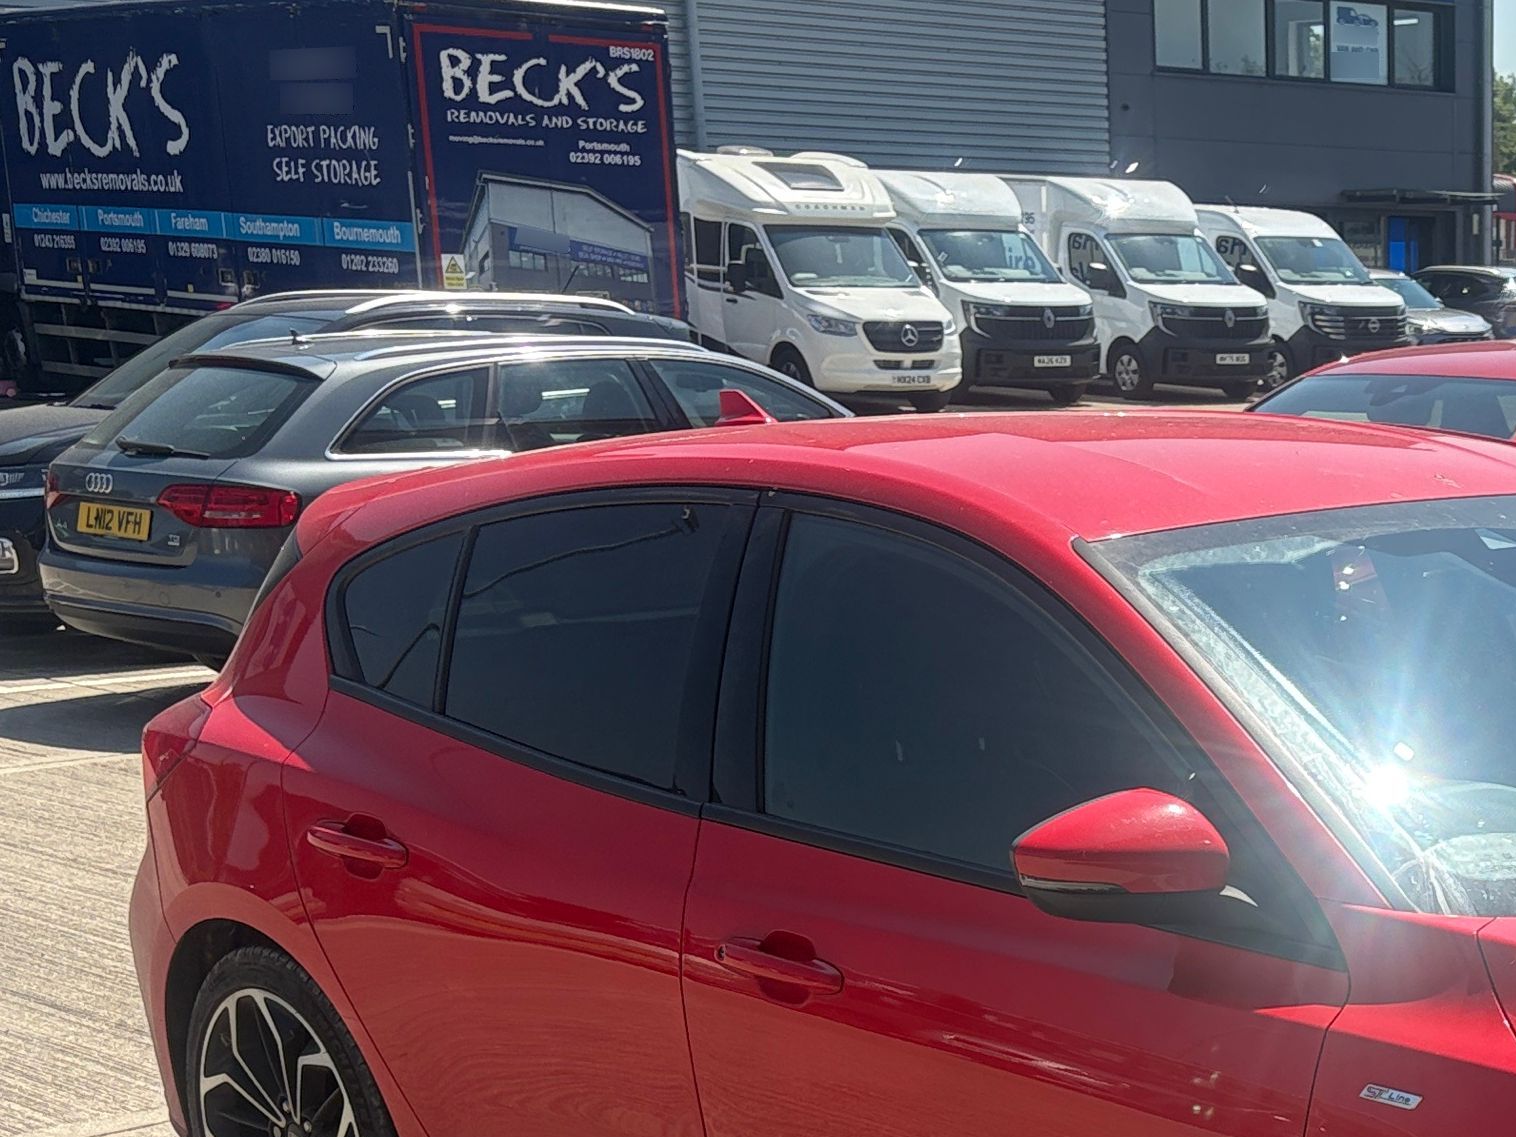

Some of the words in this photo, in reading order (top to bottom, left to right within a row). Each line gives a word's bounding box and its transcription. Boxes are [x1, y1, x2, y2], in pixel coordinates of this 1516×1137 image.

[609, 46, 655, 61] BRS1802
[440, 48, 645, 112] BECK'S
[13, 47, 190, 158] BECK'S
[447, 109, 536, 127] REMOVALS
[542, 115, 573, 129] AND
[577, 117, 648, 133] STORAGE
[267, 125, 315, 148] EXPORT
[320, 125, 379, 150] PACKING
[578, 140, 630, 152] Portsmouth
[569, 152, 601, 164] 02392
[603, 153, 641, 166] 006195
[40, 168, 184, 193] www.becksremovals.co.uk
[273, 157, 306, 182] SELF
[311, 159, 381, 186] STORAGE
[32, 207, 70, 224] Chichester
[97, 209, 144, 227] Portsmouth
[171, 212, 208, 231] Fareham
[239, 216, 300, 240] Southampton
[333, 221, 401, 244] Bournemouth
[341, 254, 366, 271] 01202
[86, 506, 114, 531] LN12
[117, 510, 142, 534] VFH
